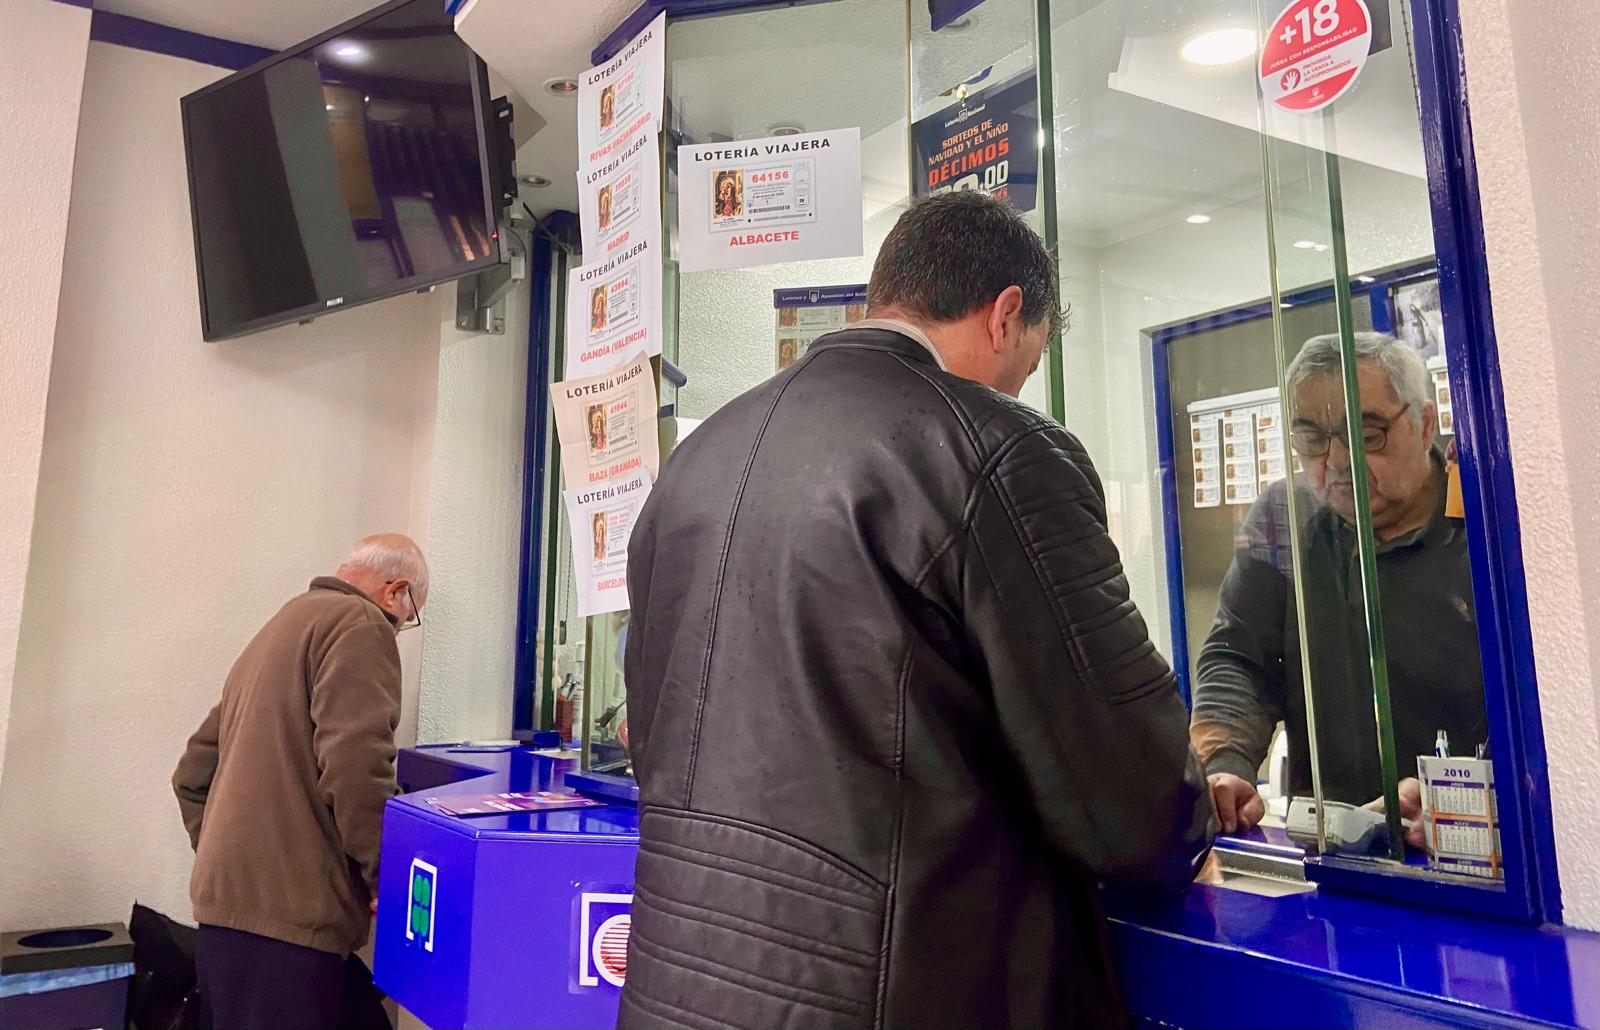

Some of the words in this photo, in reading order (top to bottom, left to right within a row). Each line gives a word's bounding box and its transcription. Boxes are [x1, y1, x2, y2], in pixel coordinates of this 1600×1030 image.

[1279, 0, 1340, 45] +18
[588, 59, 622, 85] LOTERÍA
[624, 31, 652, 62] VIAJERA
[1270, 58, 1288, 69] JUEGA
[1289, 52, 1302, 60] CON
[1302, 26, 1357, 54] RESPONSABILIDAD
[1304, 68, 1310, 76] LA
[1312, 62, 1329, 74] VENTA
[590, 112, 651, 162] RIVAS-VACIAMADRID
[695, 147, 759, 162] LOTERÍA
[765, 138, 831, 155] VIAJERA
[928, 144, 964, 166] NAVIDAD
[966, 140, 973, 148] Y
[974, 135, 984, 146] EL
[986, 122, 1008, 140] NIÑO
[942, 126, 979, 150] SORTEOS
[981, 118, 992, 131] DE
[587, 159, 619, 184] LOTERÍA
[621, 134, 647, 162] VIAJERA
[928, 138, 1009, 187] DÉCIMOS
[752, 171, 789, 183] 64156
[607, 232, 629, 250] MADRID
[730, 230, 800, 246] ALBACETE
[580, 259, 615, 282] LOTERÍA
[617, 241, 648, 265] VIAJERA
[580, 344, 610, 362] GANDÍA
[612, 328, 647, 354] (VALENCIA)
[566, 382, 614, 398] LOTERÍA
[616, 364, 642, 386] VIAJERA
[588, 469, 608, 482] BAZA
[609, 457, 641, 479] (GRANADA)
[577, 487, 615, 504] LOTERÍA
[616, 478, 643, 495] VIAJERA
[597, 576, 627, 591] BARCELON
[1444, 768, 1471, 778] 2010
